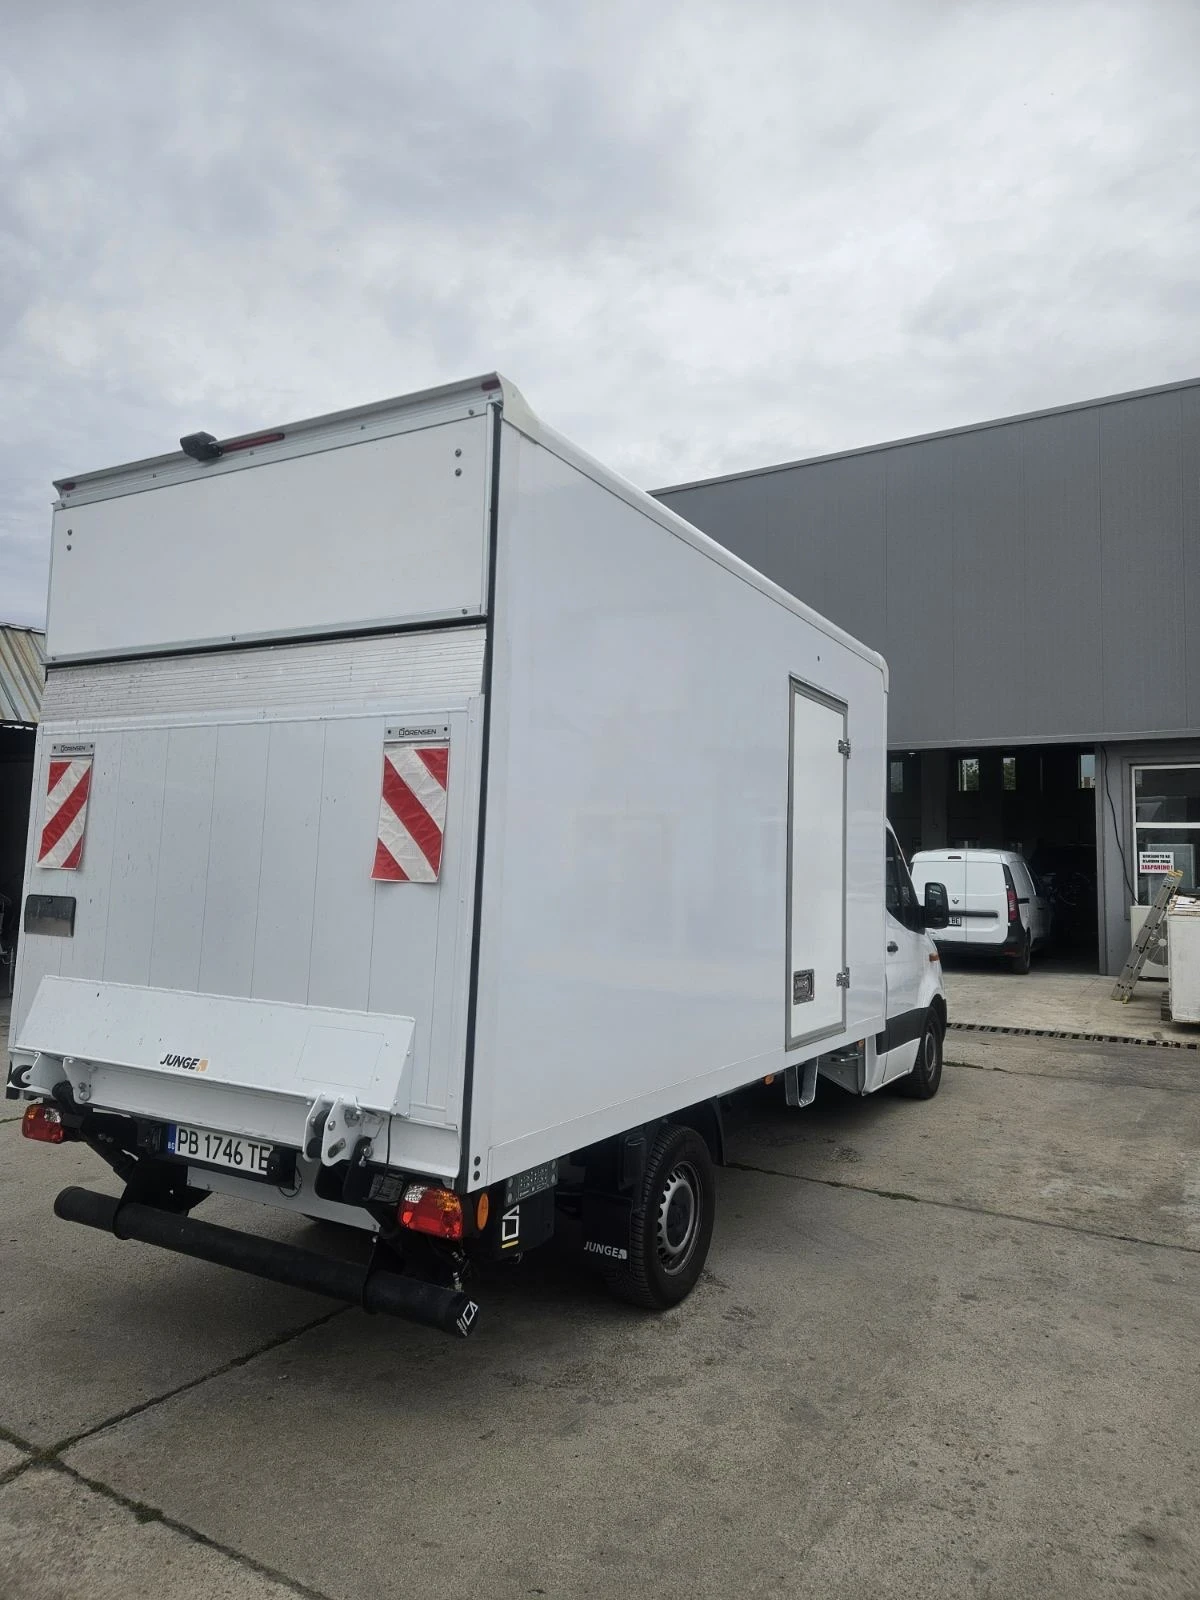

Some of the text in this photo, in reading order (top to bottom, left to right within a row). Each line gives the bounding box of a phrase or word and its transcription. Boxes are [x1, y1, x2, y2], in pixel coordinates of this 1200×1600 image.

[160, 1053, 201, 1070] JUNGE
[177, 1128, 271, 1172] PB 1746 TE
[583, 1241, 620, 1258] JUNGE
